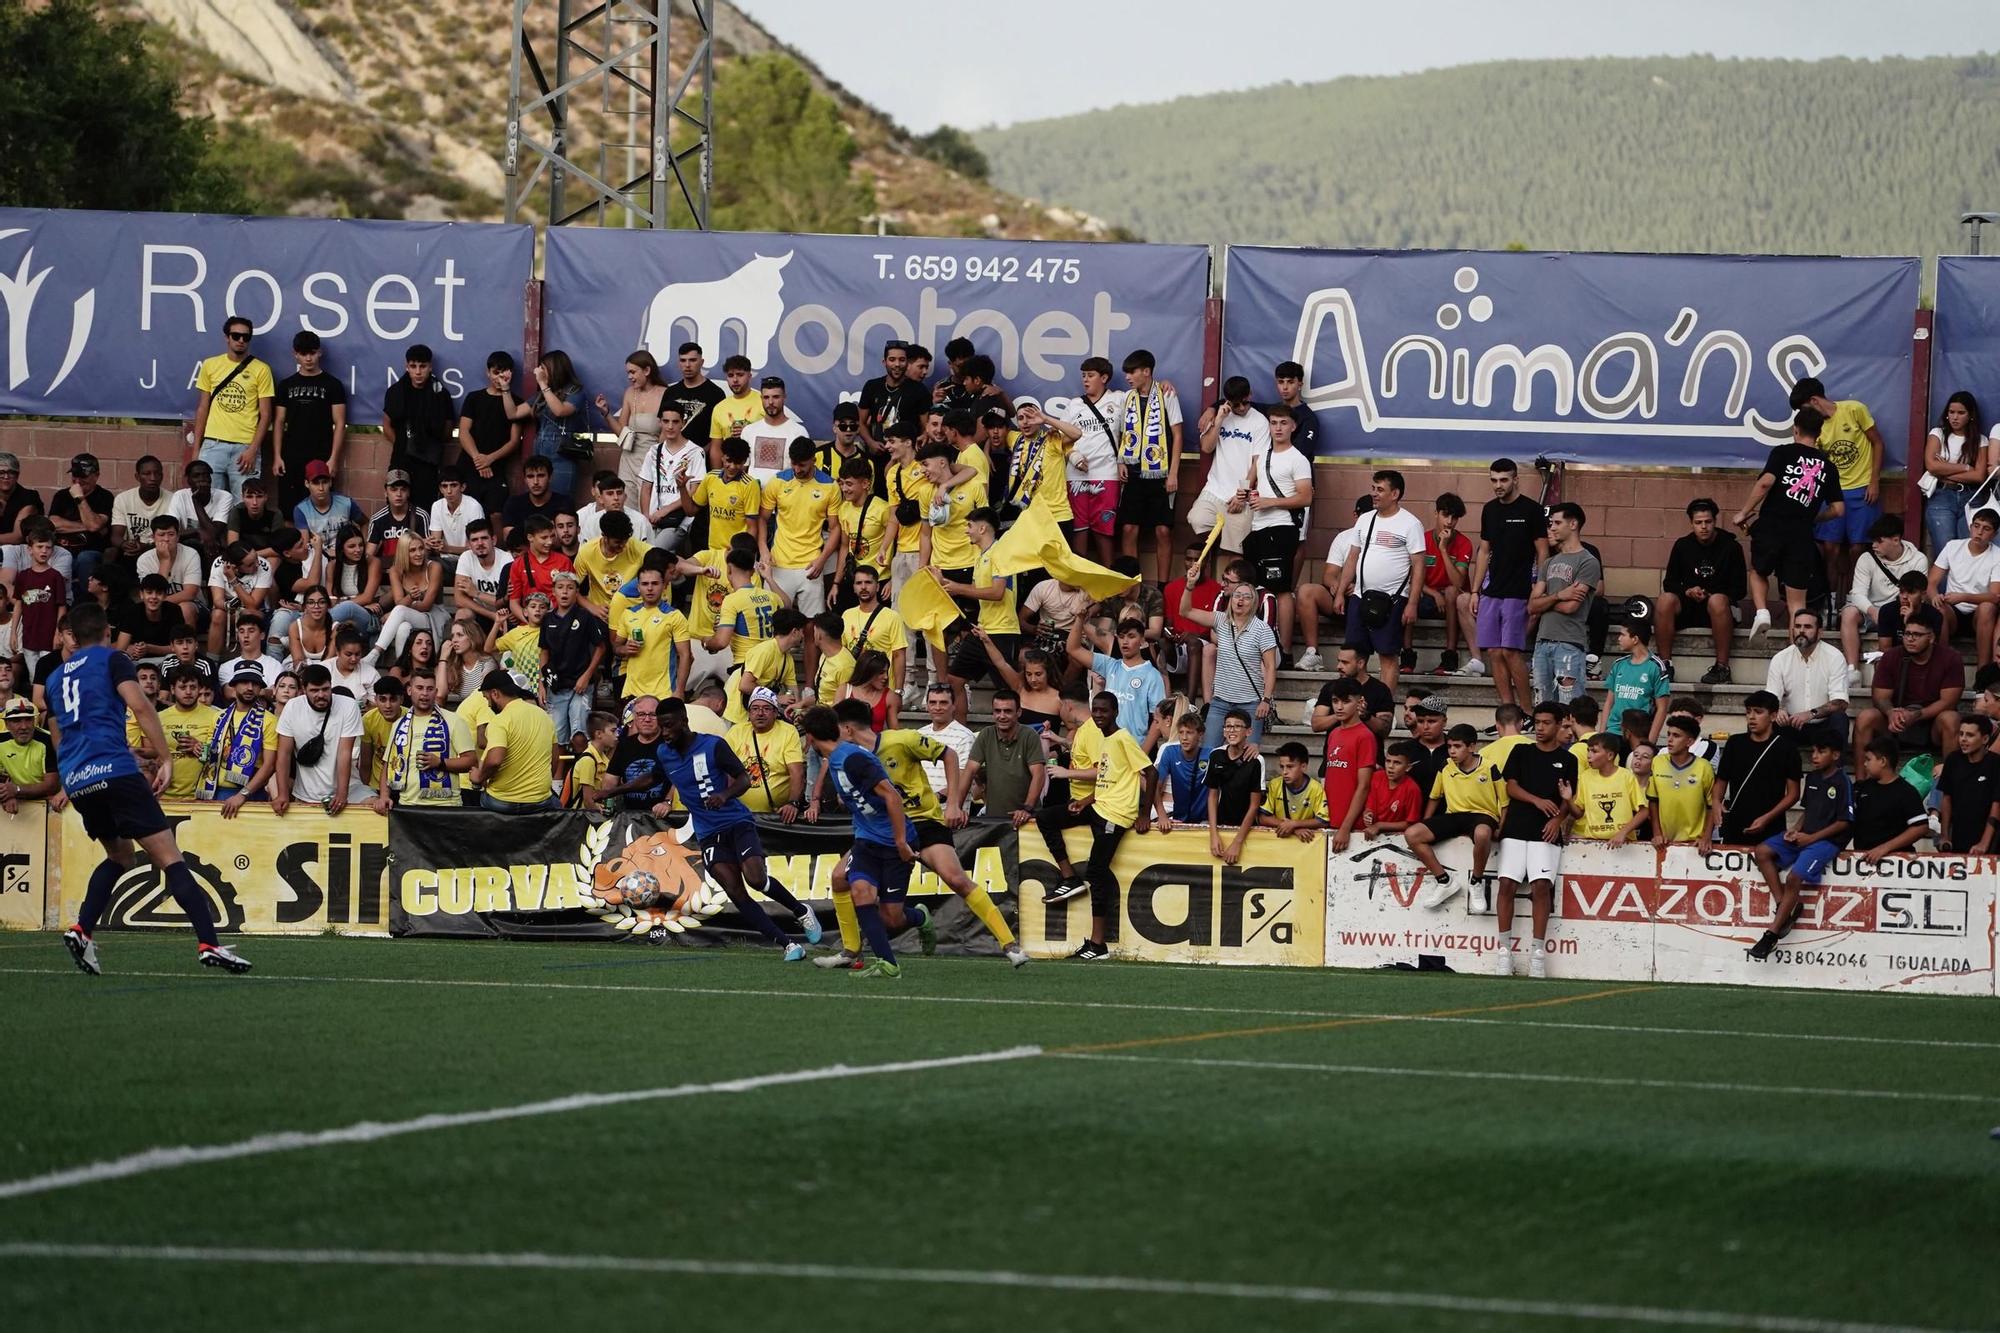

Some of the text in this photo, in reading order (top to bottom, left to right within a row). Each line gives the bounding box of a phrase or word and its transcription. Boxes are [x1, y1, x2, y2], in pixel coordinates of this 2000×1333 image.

[873, 254, 1080, 284] T. 659 942 475
[141, 244, 466, 341] Roset
[1785, 464, 1826, 483] SOAL
[1797, 456, 1825, 469] ANTI
[384, 526, 409, 539] adid
[62, 676, 81, 722] 4
[401, 863, 583, 916] CURVA
[1341, 929, 1578, 957] www.trivazquz.om
[1889, 954, 1972, 973] IGUALADA
